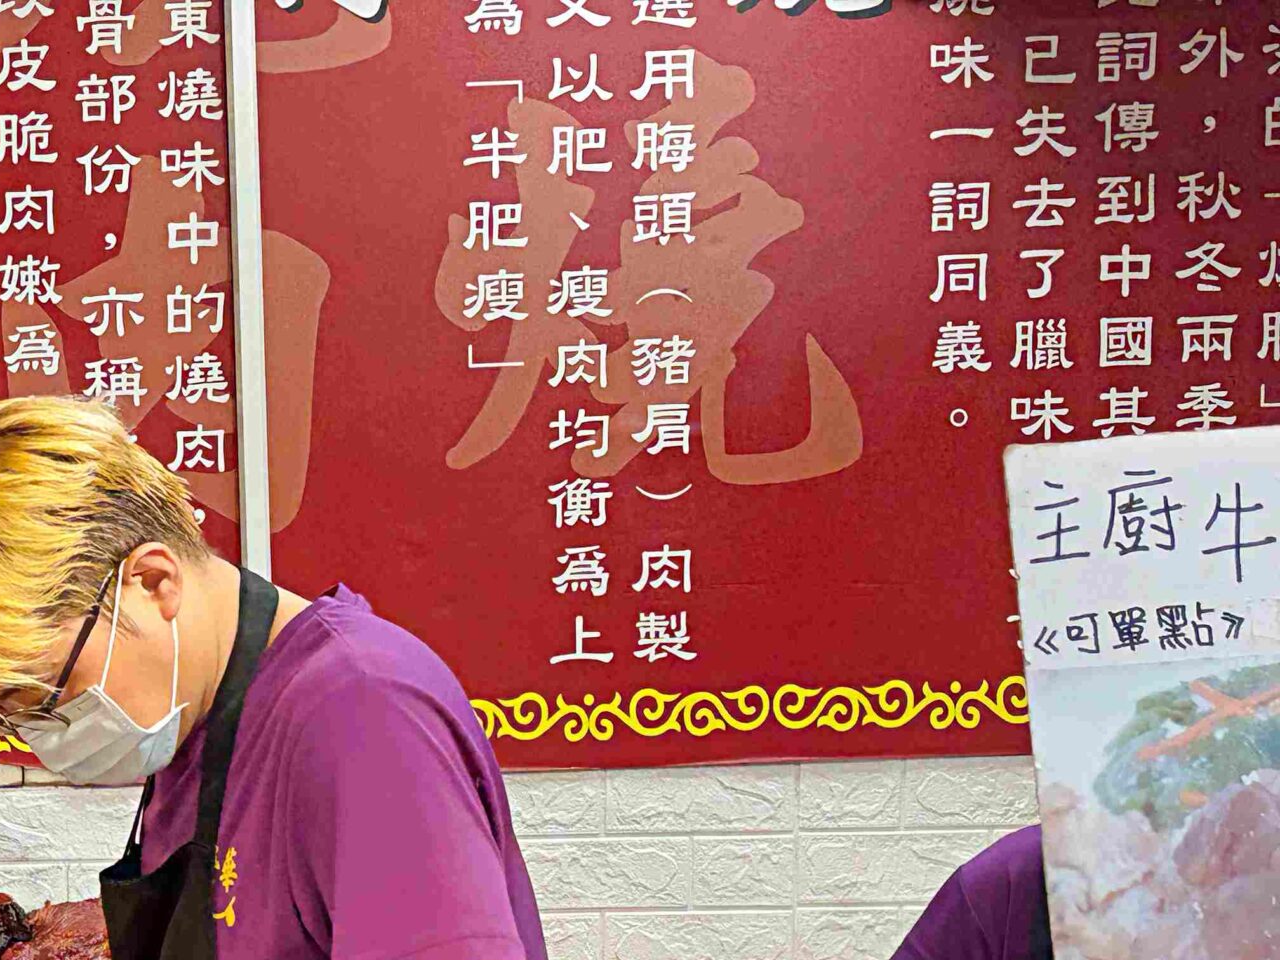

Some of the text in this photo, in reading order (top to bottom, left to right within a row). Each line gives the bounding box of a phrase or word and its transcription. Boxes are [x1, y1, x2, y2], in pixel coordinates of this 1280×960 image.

[74, 0, 148, 443] 骨部份，亦稱
[157, 0, 231, 525] 東燒味中的燒肉，
[1009, 35, 1078, 441] 已失去了臘味
[1092, 0, 1160, 437] 詞傳到中國其
[1175, 0, 1246, 433] 外，秋冬兩季
[1029, 470, 1279, 583] 主廚牛
